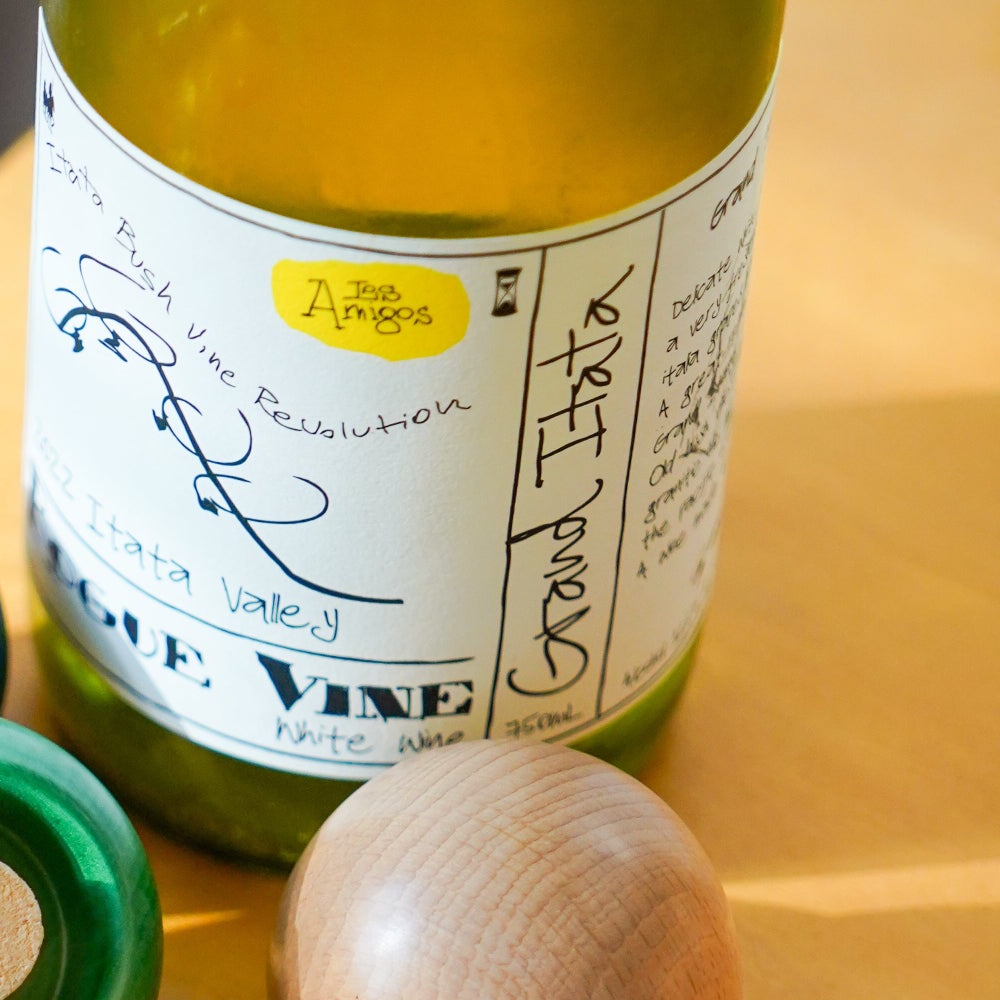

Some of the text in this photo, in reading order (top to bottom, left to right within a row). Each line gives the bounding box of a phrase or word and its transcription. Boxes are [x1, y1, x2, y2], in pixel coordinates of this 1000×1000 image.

[114, 216, 172, 315] Bush
[187, 322, 236, 388] Vine
[254, 386, 472, 439] Revolution
[301, 278, 433, 335] Amigos
[506, 263, 635, 697] Grand Itata
[87, 494, 192, 596] Itata
[220, 576, 340, 642] Valley
[256, 651, 474, 723] VINE
[275, 715, 374, 756] White
